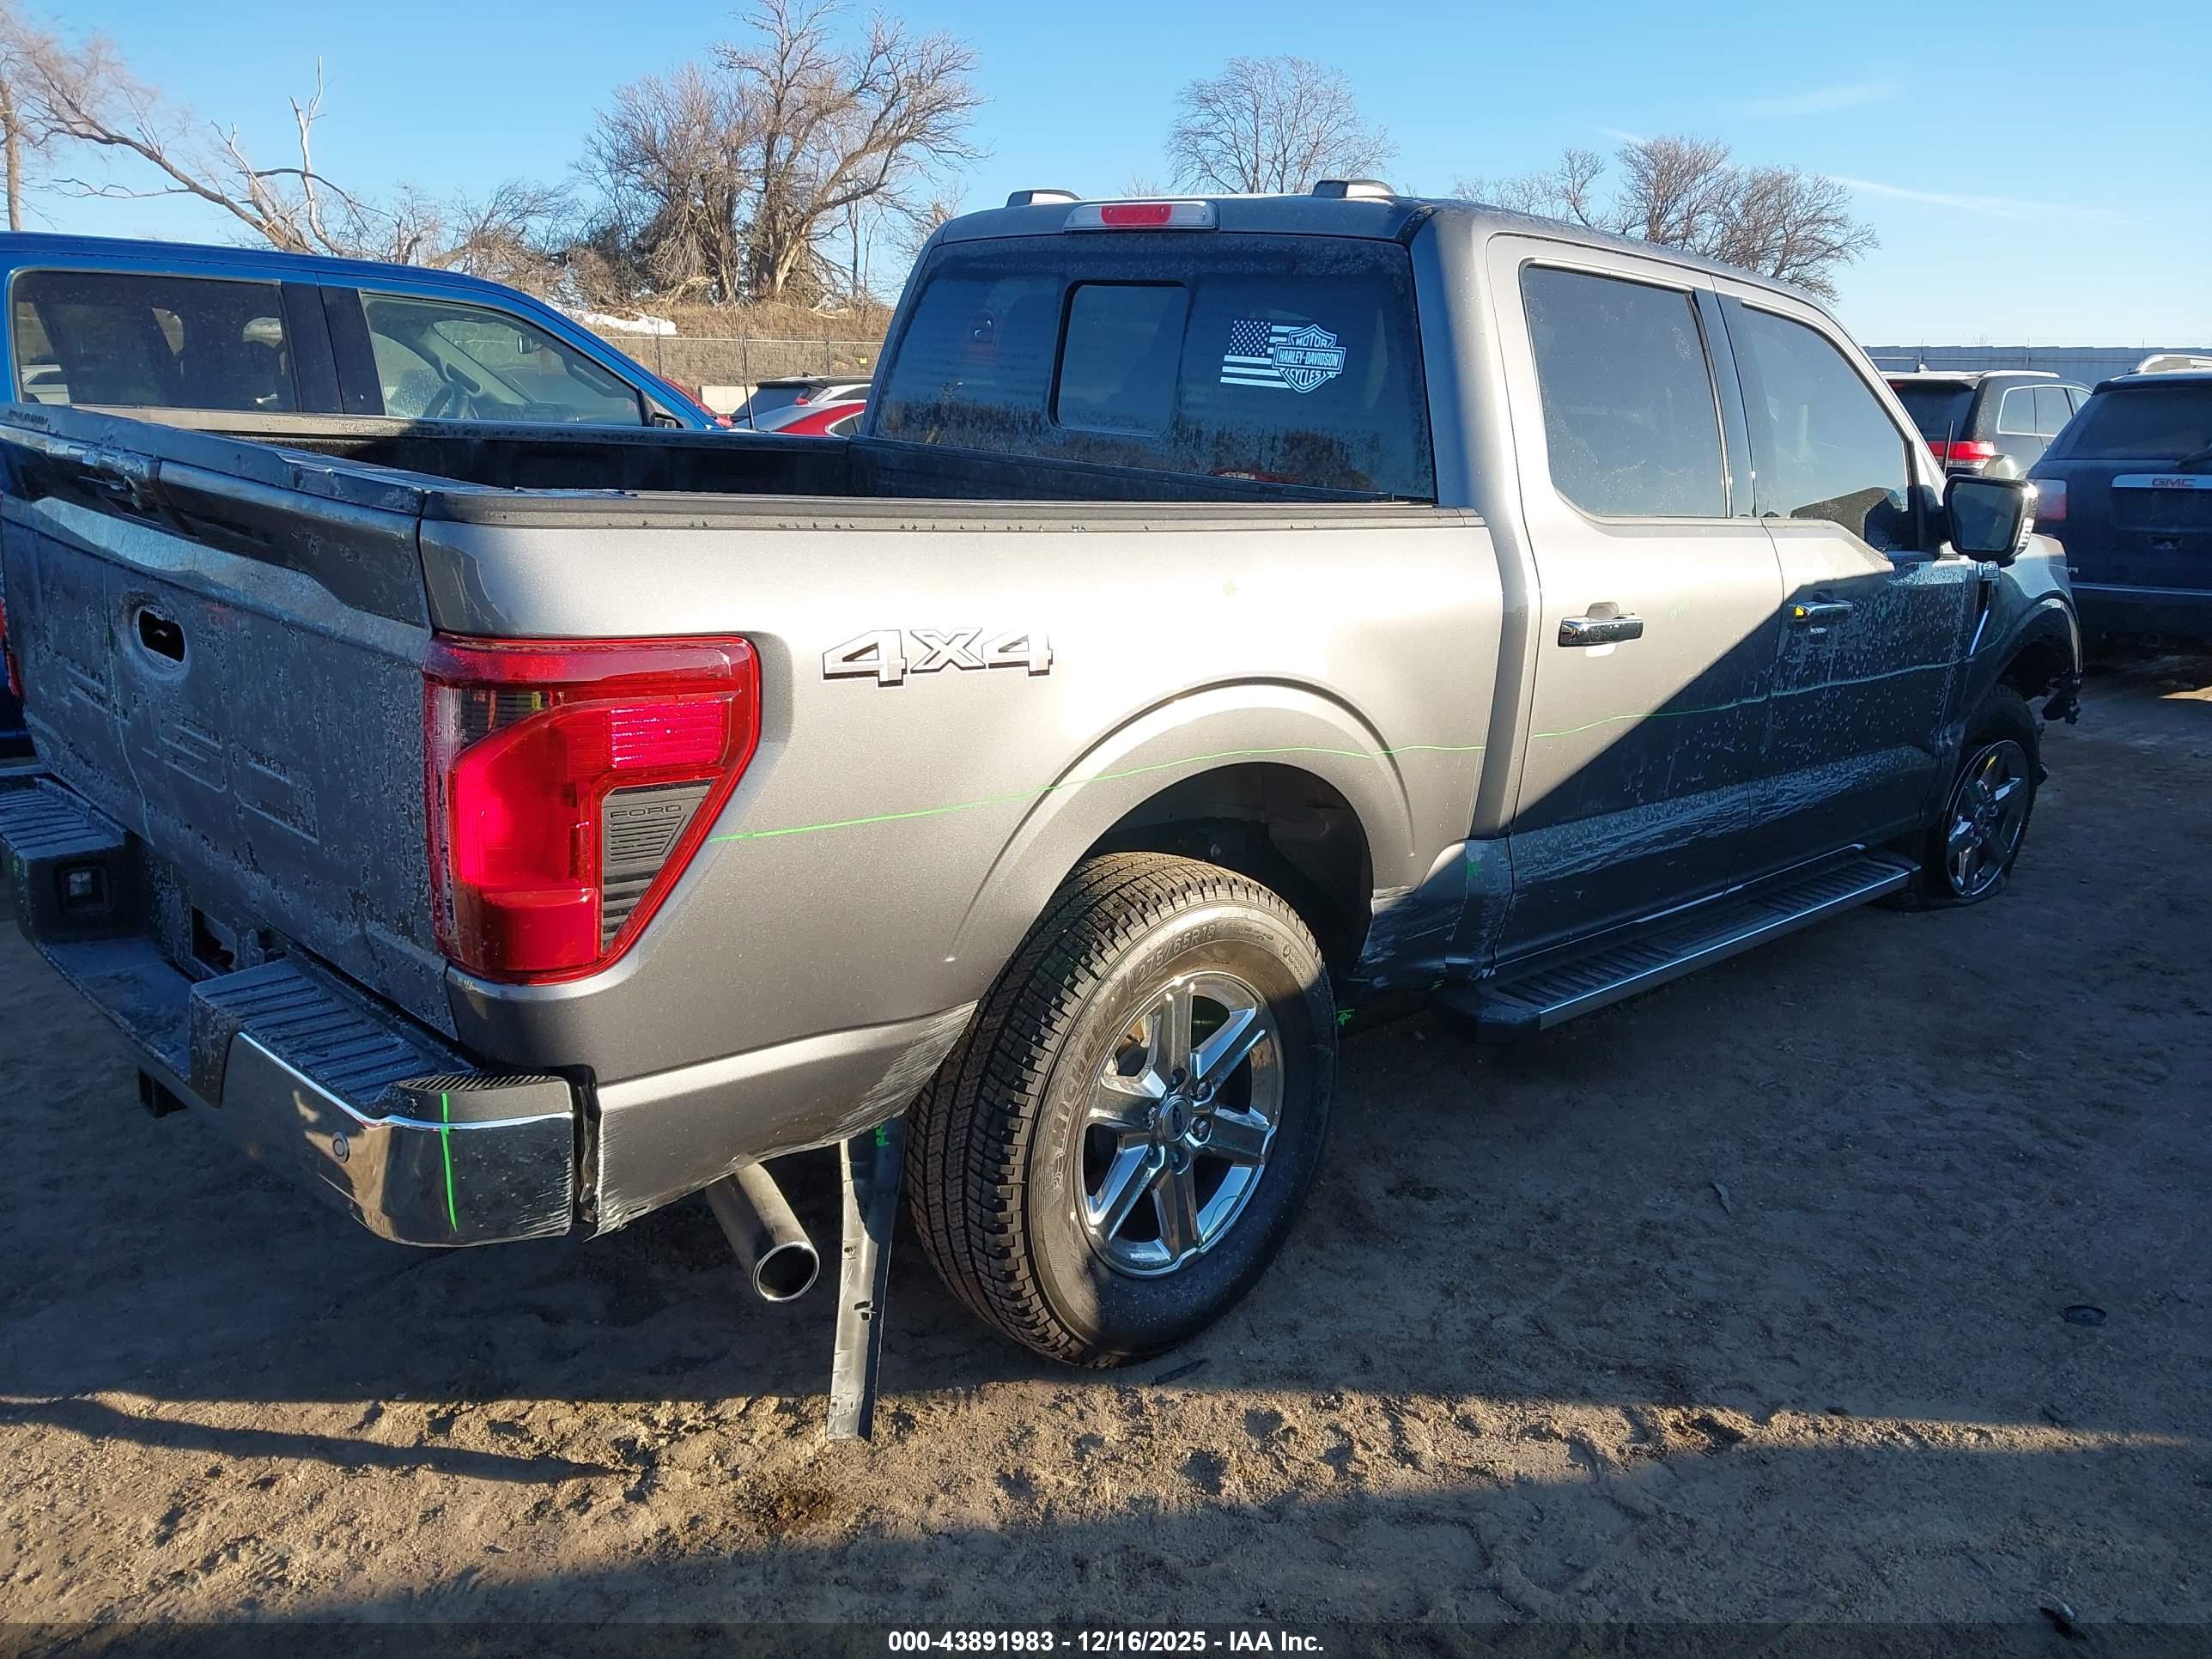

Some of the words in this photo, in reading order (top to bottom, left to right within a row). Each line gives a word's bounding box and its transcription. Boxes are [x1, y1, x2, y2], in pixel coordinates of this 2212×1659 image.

[1295, 331, 1328, 349] MOTOR
[1279, 349, 1340, 367] HARLEY-DAVIDSON
[1289, 368, 1322, 386] CYCLES
[2151, 477, 2197, 487] GMC
[610, 804, 682, 819] FORD
